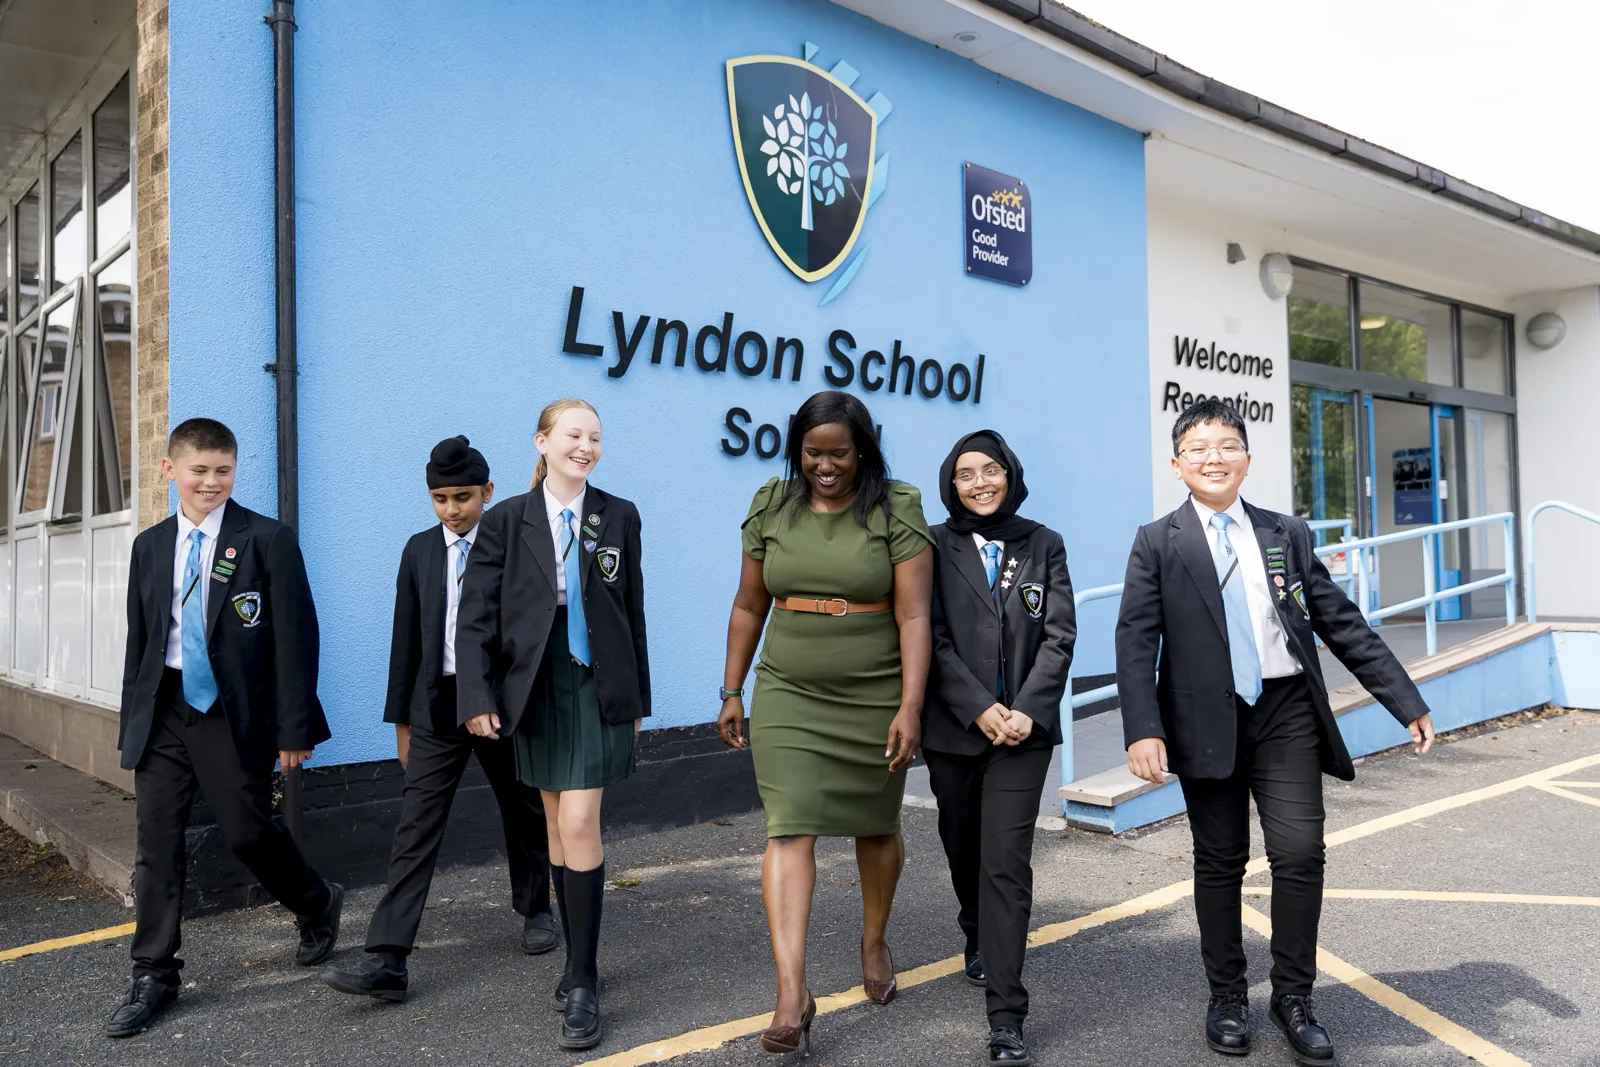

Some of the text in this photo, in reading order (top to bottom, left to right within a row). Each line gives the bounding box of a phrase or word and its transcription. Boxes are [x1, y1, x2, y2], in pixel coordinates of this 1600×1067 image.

[972, 194, 1025, 232] Ofsted
[972, 229, 997, 247] Good
[972, 245, 1009, 266] Provider
[562, 286, 986, 404] Lyndon School
[1174, 335, 1273, 378] Welcome
[1163, 381, 1274, 422] Retion
